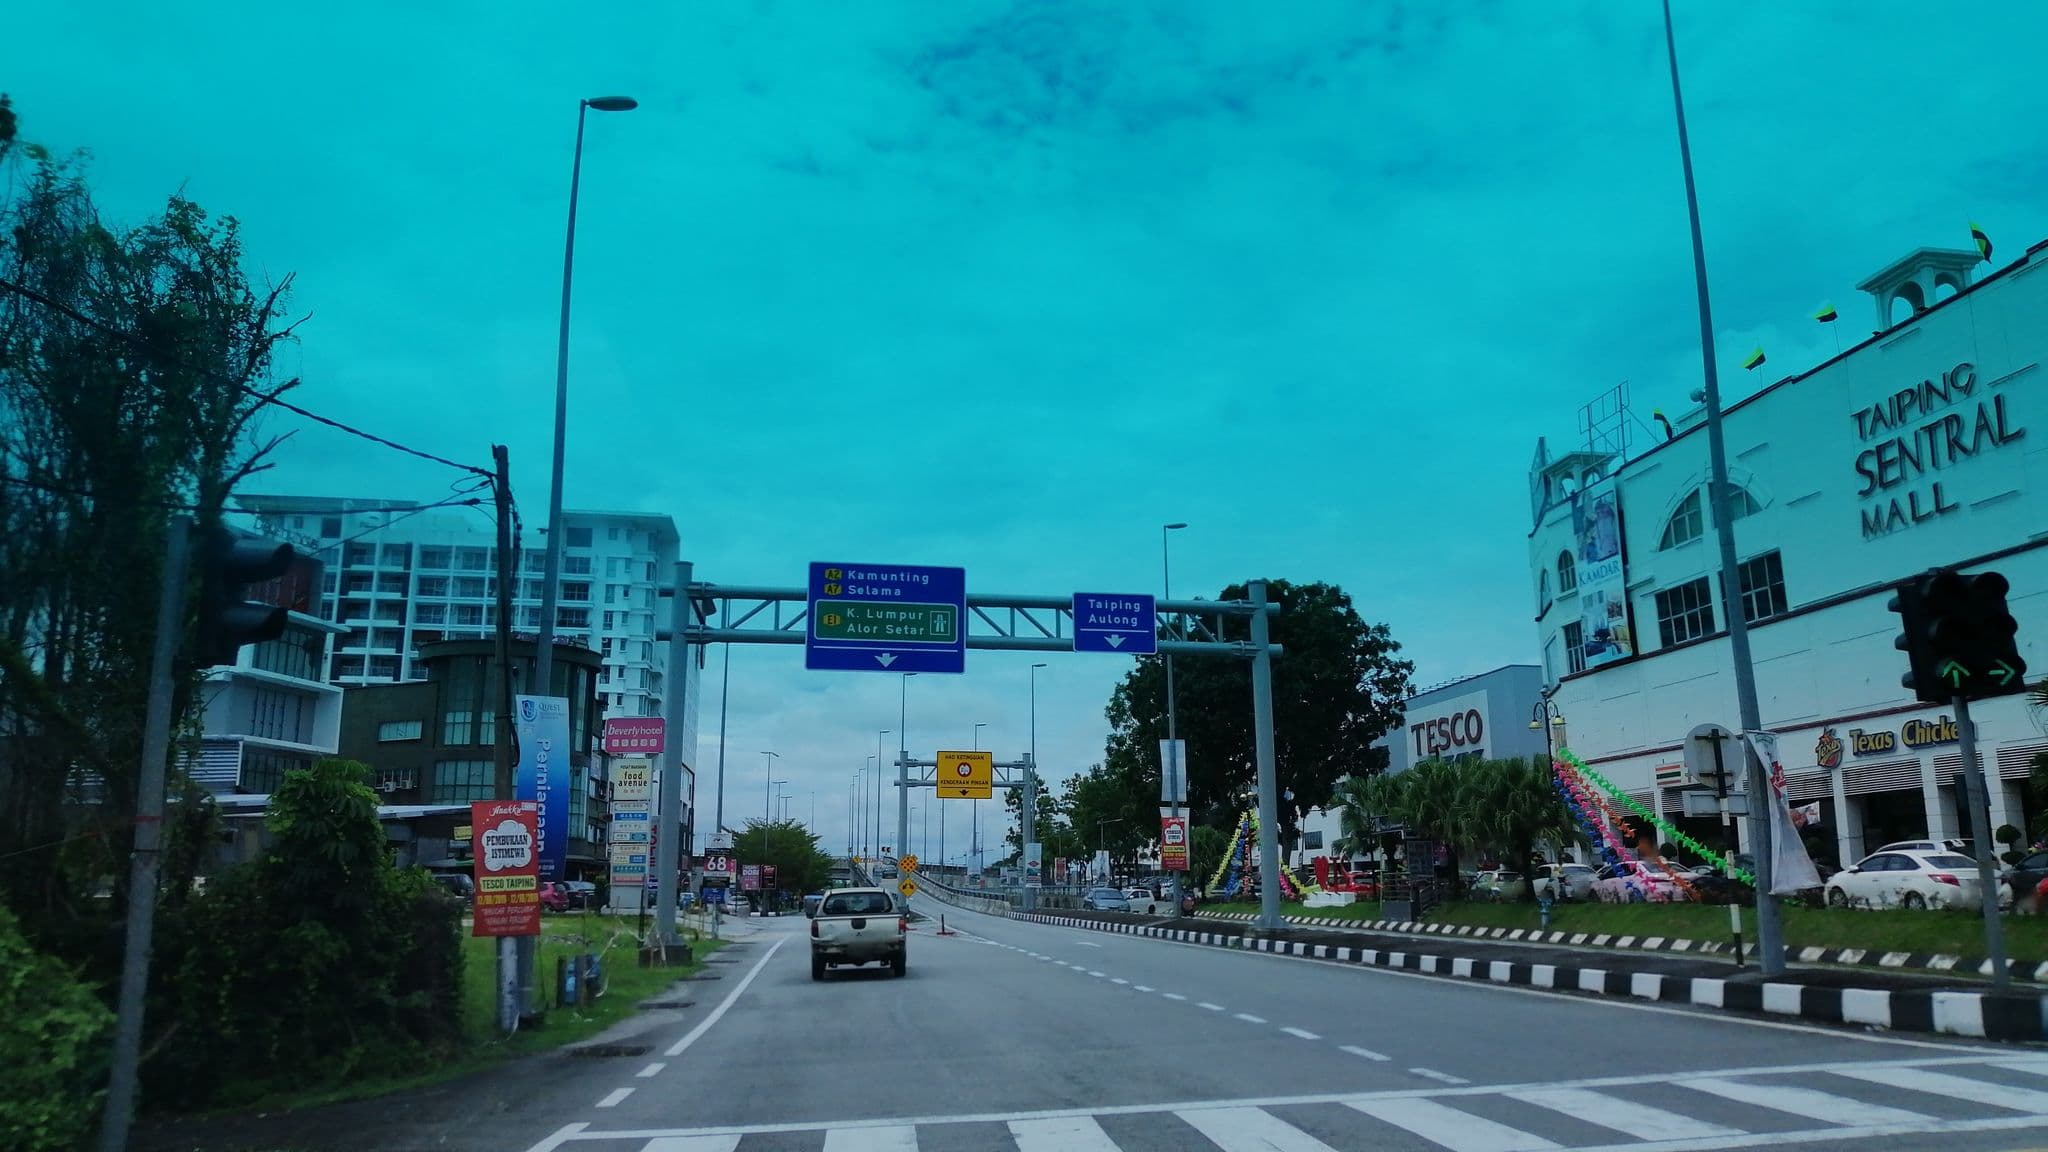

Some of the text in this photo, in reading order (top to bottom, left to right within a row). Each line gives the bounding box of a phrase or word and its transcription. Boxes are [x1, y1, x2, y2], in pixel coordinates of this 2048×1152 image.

[1851, 362, 1977, 441] TAIPING
[1855, 393, 2026, 498] SENTRAL
[1861, 481, 1960, 538] MALL
[827, 569, 929, 585] A2 Kamunting
[1580, 560, 1621, 586] KAMDAR
[848, 585, 901, 596] Selama
[1088, 599, 1141, 612] Taiping
[847, 608, 924, 622] K. Lumpur
[1088, 614, 1138, 627] Aulong
[847, 624, 924, 636] Alor Setar
[1411, 708, 1483, 756] TESCO
[1851, 715, 1963, 753] Texas Chicke
[624, 771, 643, 780] food
[486, 835, 528, 847] PEMBUKAAN
[491, 847, 526, 859] ISTIMEWA
[707, 856, 727, 871] 68
[482, 878, 534, 889] TESCO TAIPING
